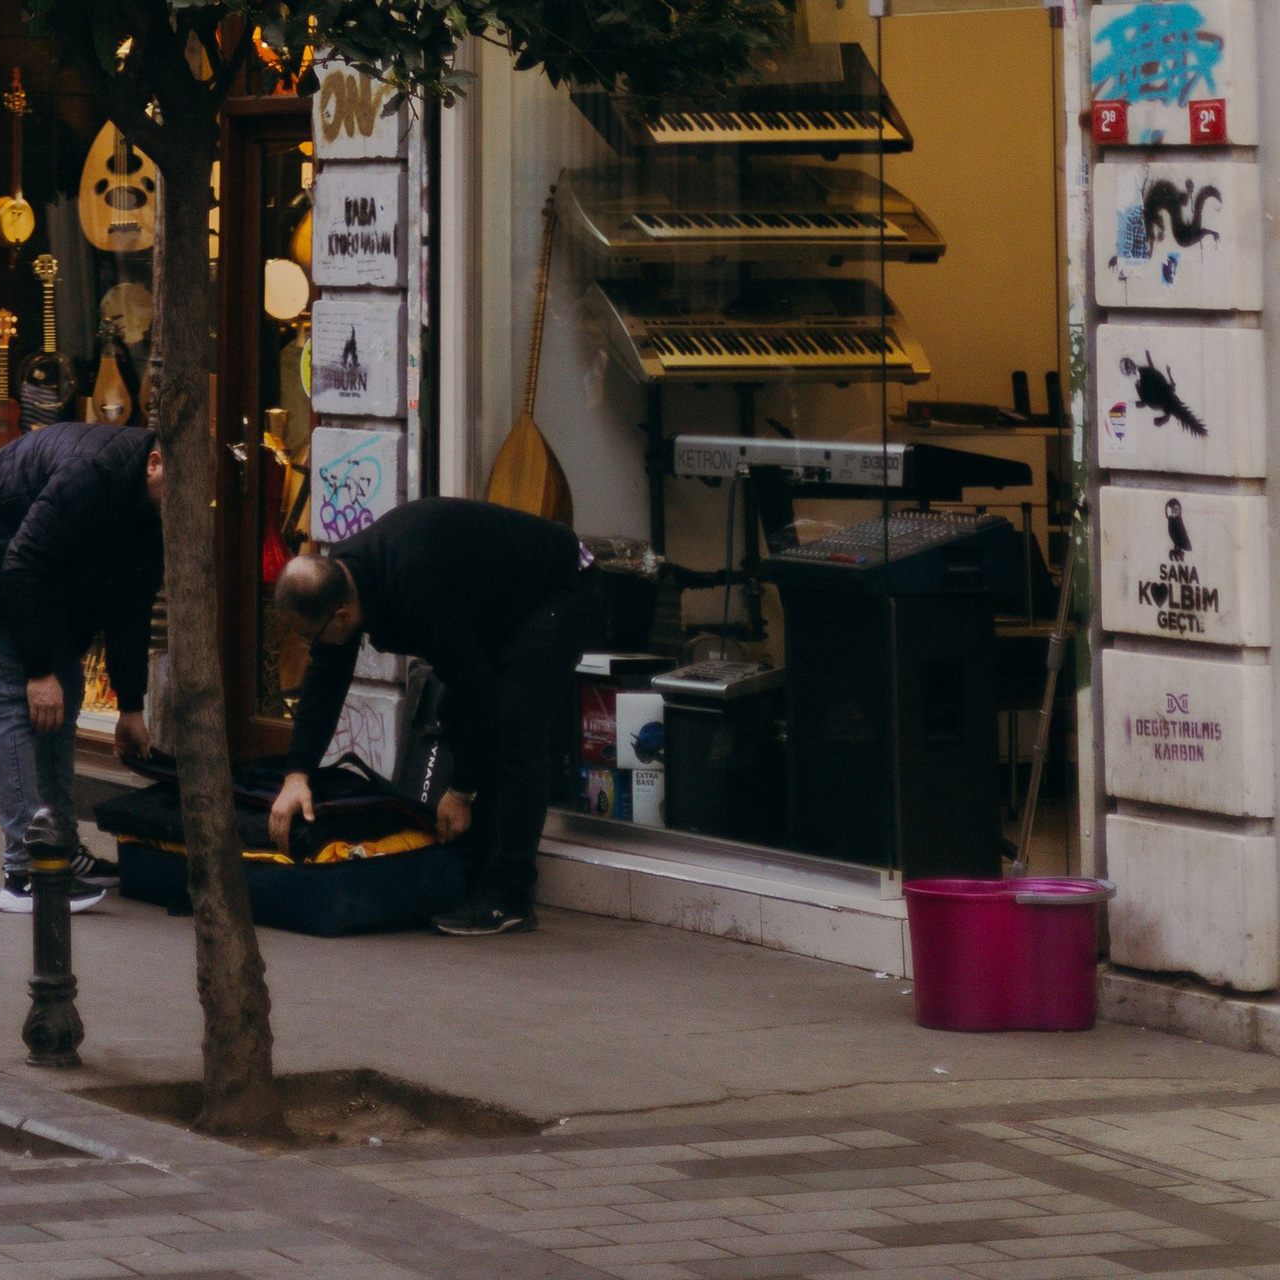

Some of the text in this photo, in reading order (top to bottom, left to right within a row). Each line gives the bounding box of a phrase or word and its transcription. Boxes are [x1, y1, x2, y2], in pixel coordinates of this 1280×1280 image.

[1101, 109, 1116, 133] 2B
[1199, 110, 1216, 133] 2A
[677, 448, 732, 471] KETRON
[1159, 564, 1200, 584] SANA
[1154, 743, 1205, 762] KARBON
[635, 772, 659, 780] EXTRA
[635, 779, 655, 787] BASS
